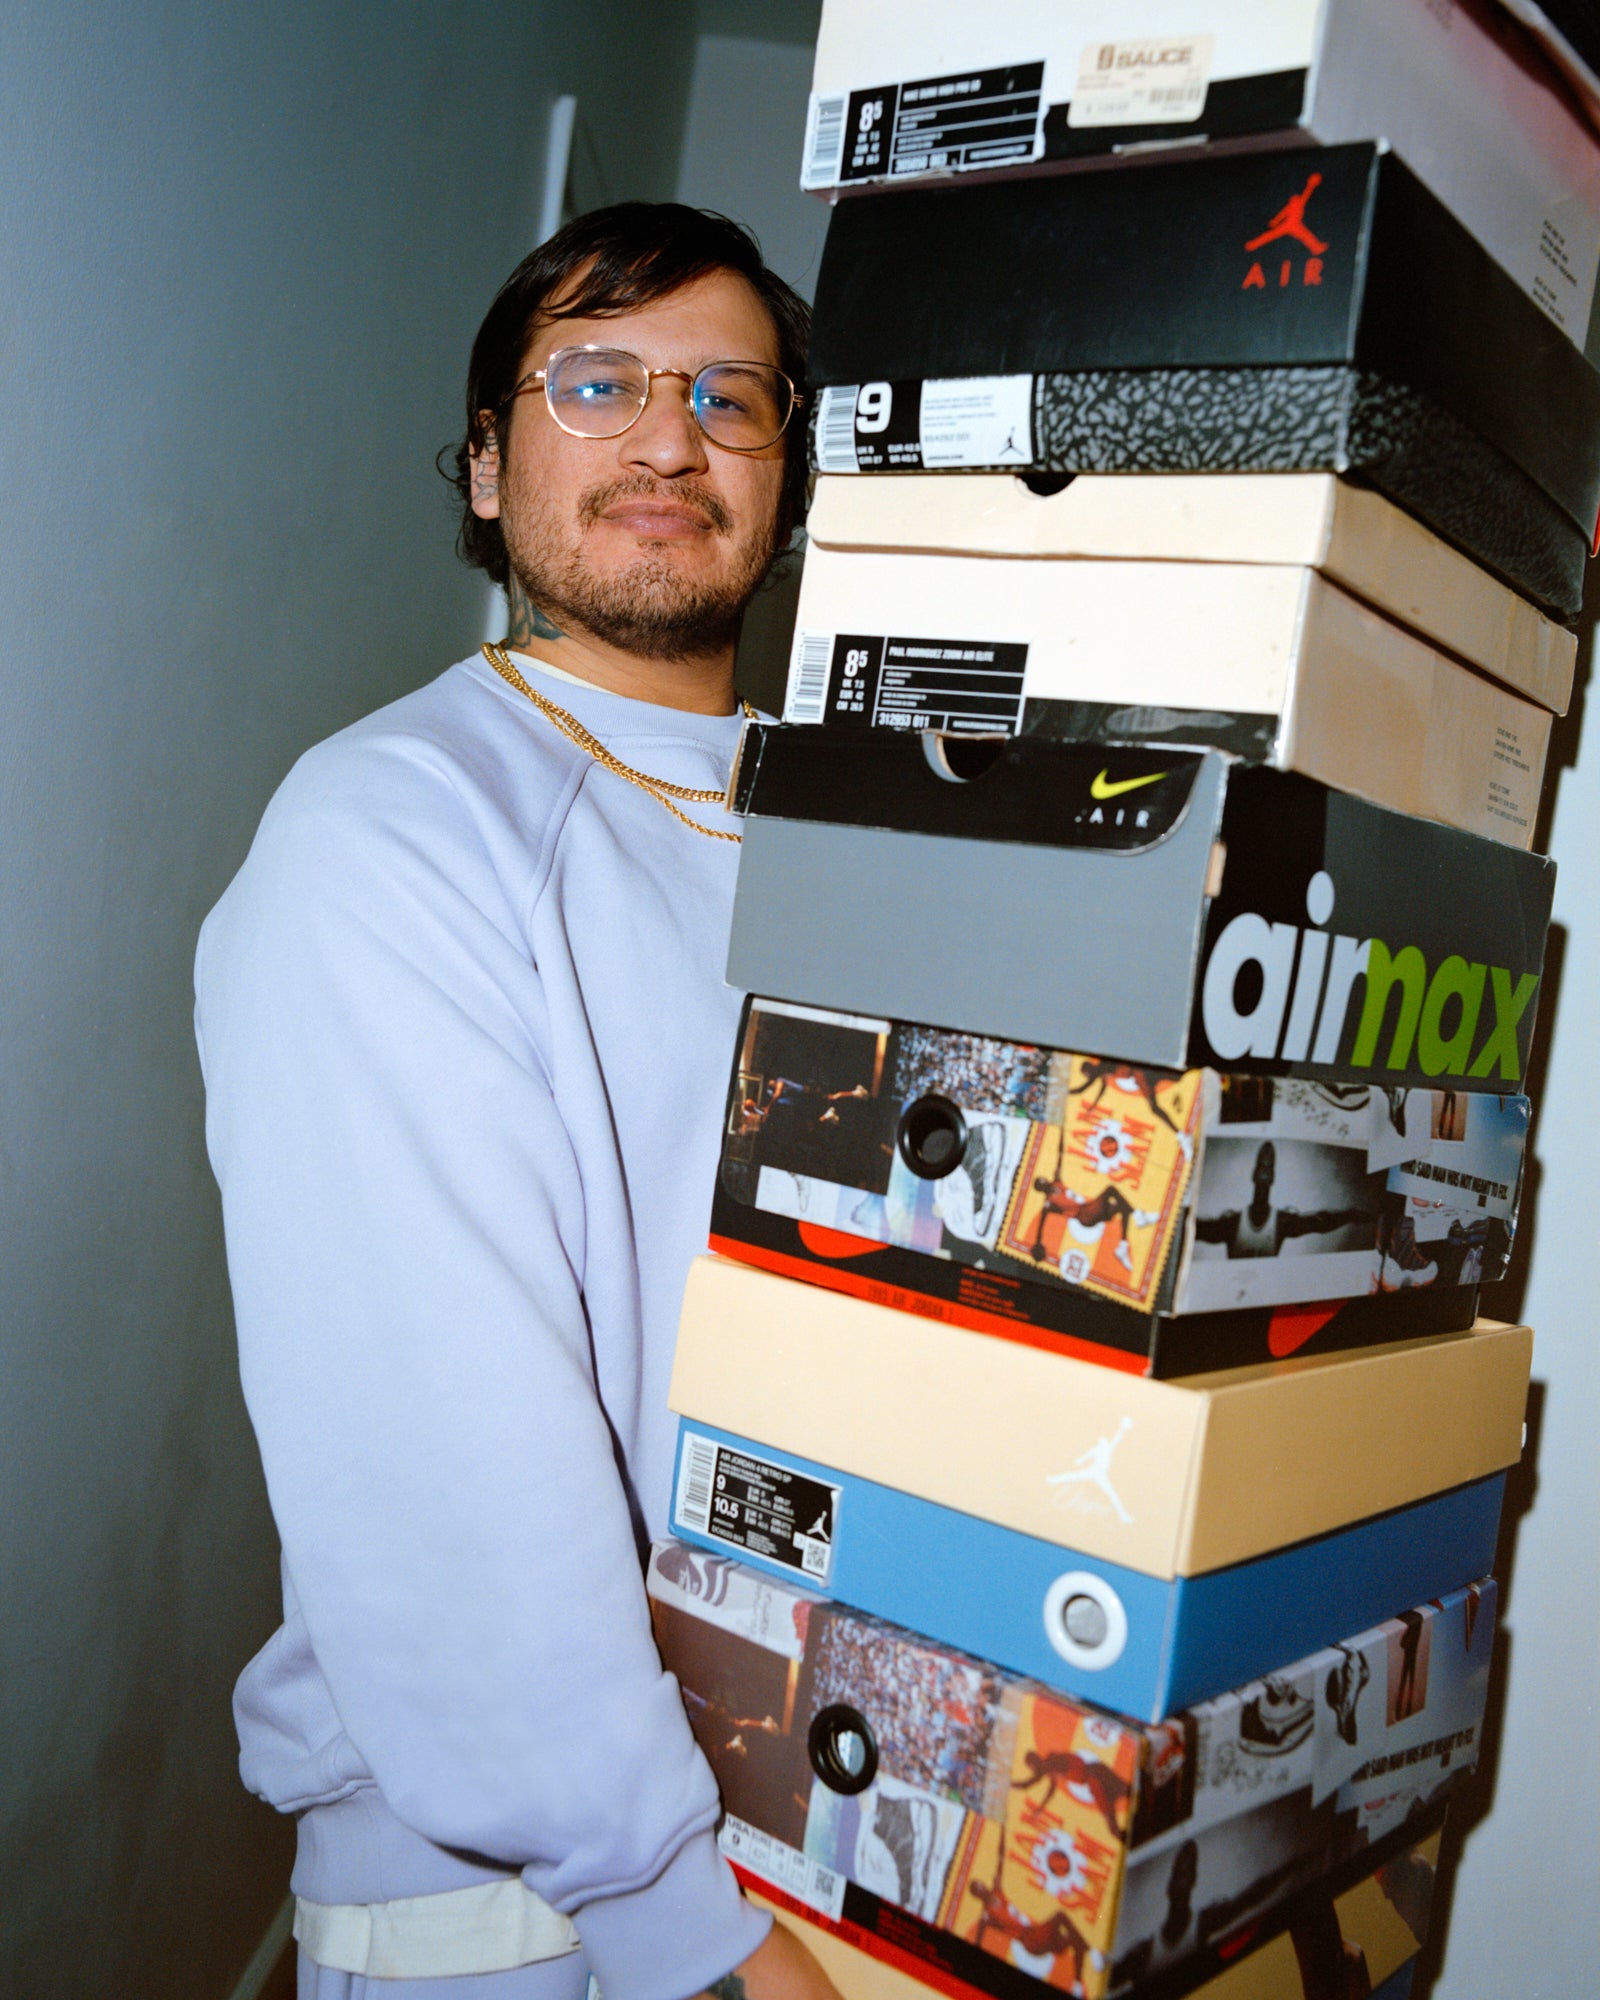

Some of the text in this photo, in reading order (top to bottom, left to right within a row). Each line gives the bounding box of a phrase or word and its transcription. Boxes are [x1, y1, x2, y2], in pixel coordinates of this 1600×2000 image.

[1242, 258, 1323, 289] AIR
[856, 382, 893, 433] 9
[1089, 806, 1150, 828] AIR
[1068, 1100, 1113, 1175] JAM
[1107, 1114, 1156, 1191] SLAM
[716, 1474, 726, 1491] 9
[714, 1496, 739, 1519] 10.5
